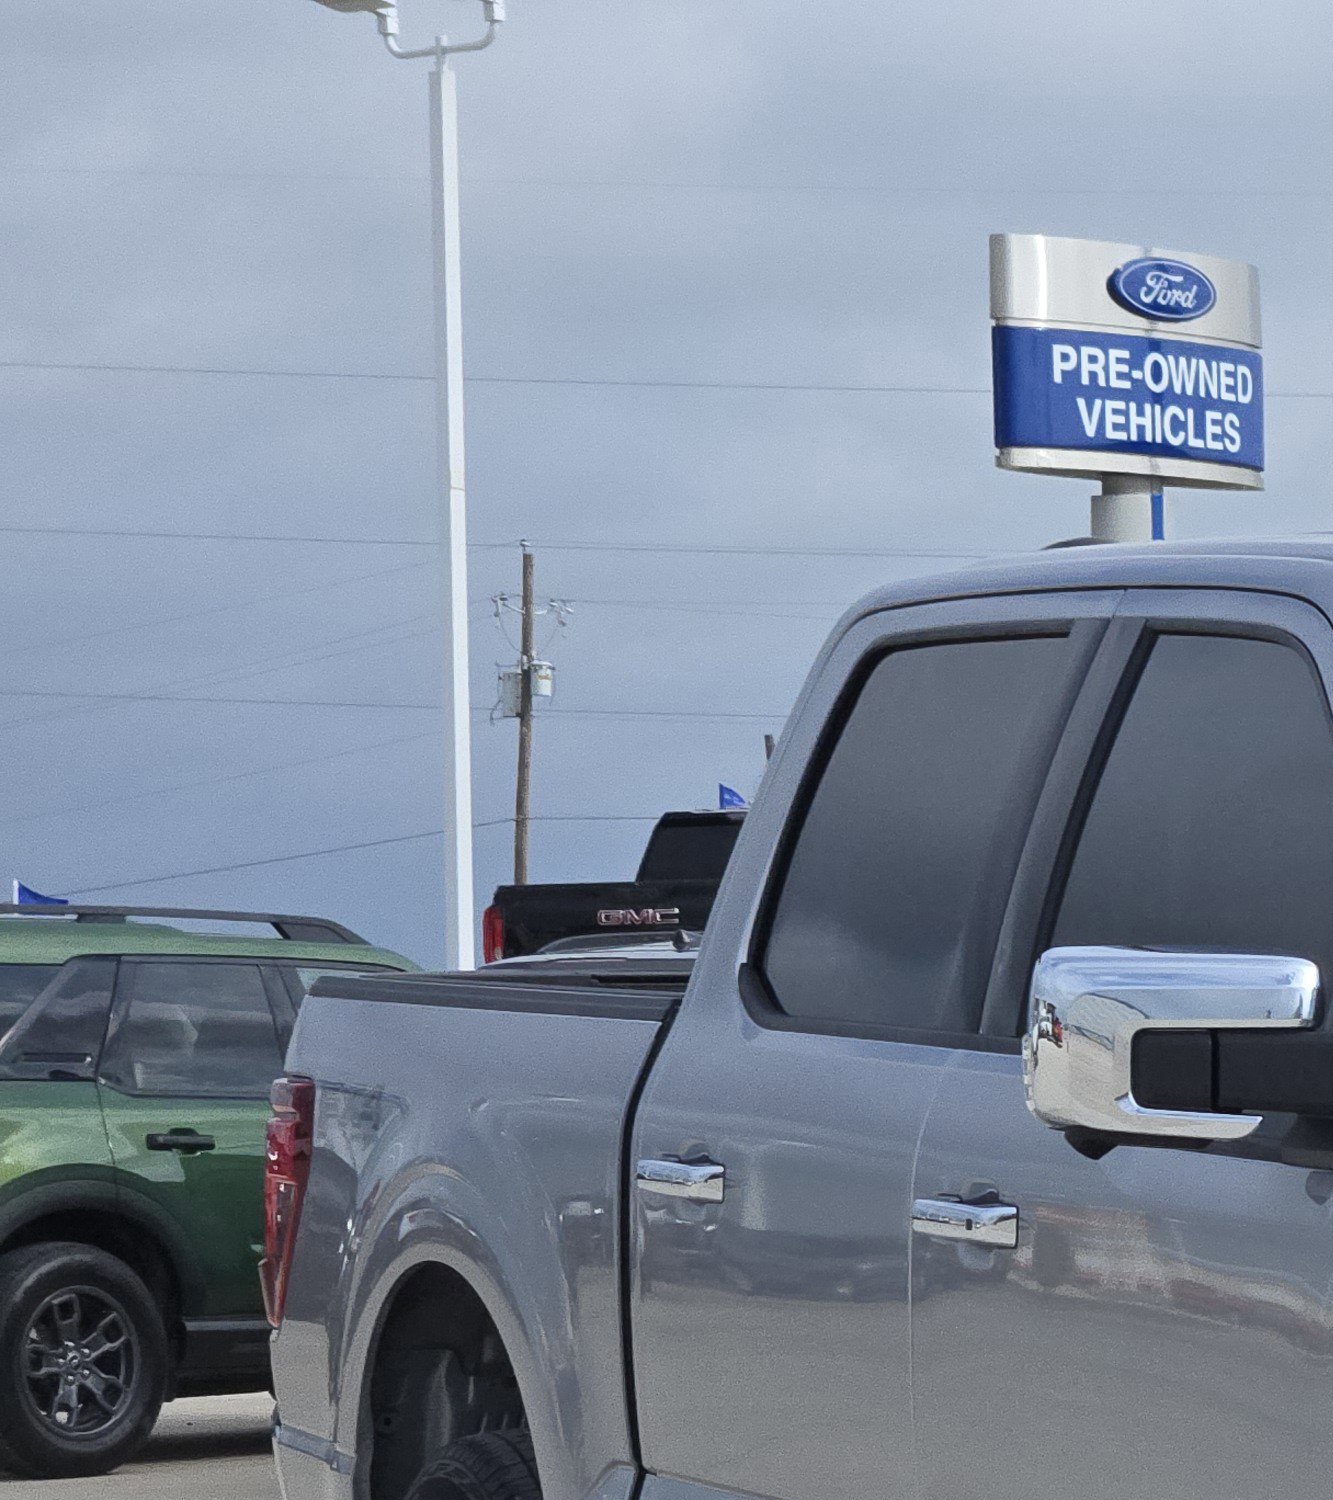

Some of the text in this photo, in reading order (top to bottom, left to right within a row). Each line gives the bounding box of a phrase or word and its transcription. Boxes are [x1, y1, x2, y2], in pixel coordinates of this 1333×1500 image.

[1140, 270, 1197, 309] Ford
[1052, 343, 1253, 404] PRE-OWNED
[1076, 397, 1241, 453] VEHICLES
[597, 907, 680, 926] GMC
